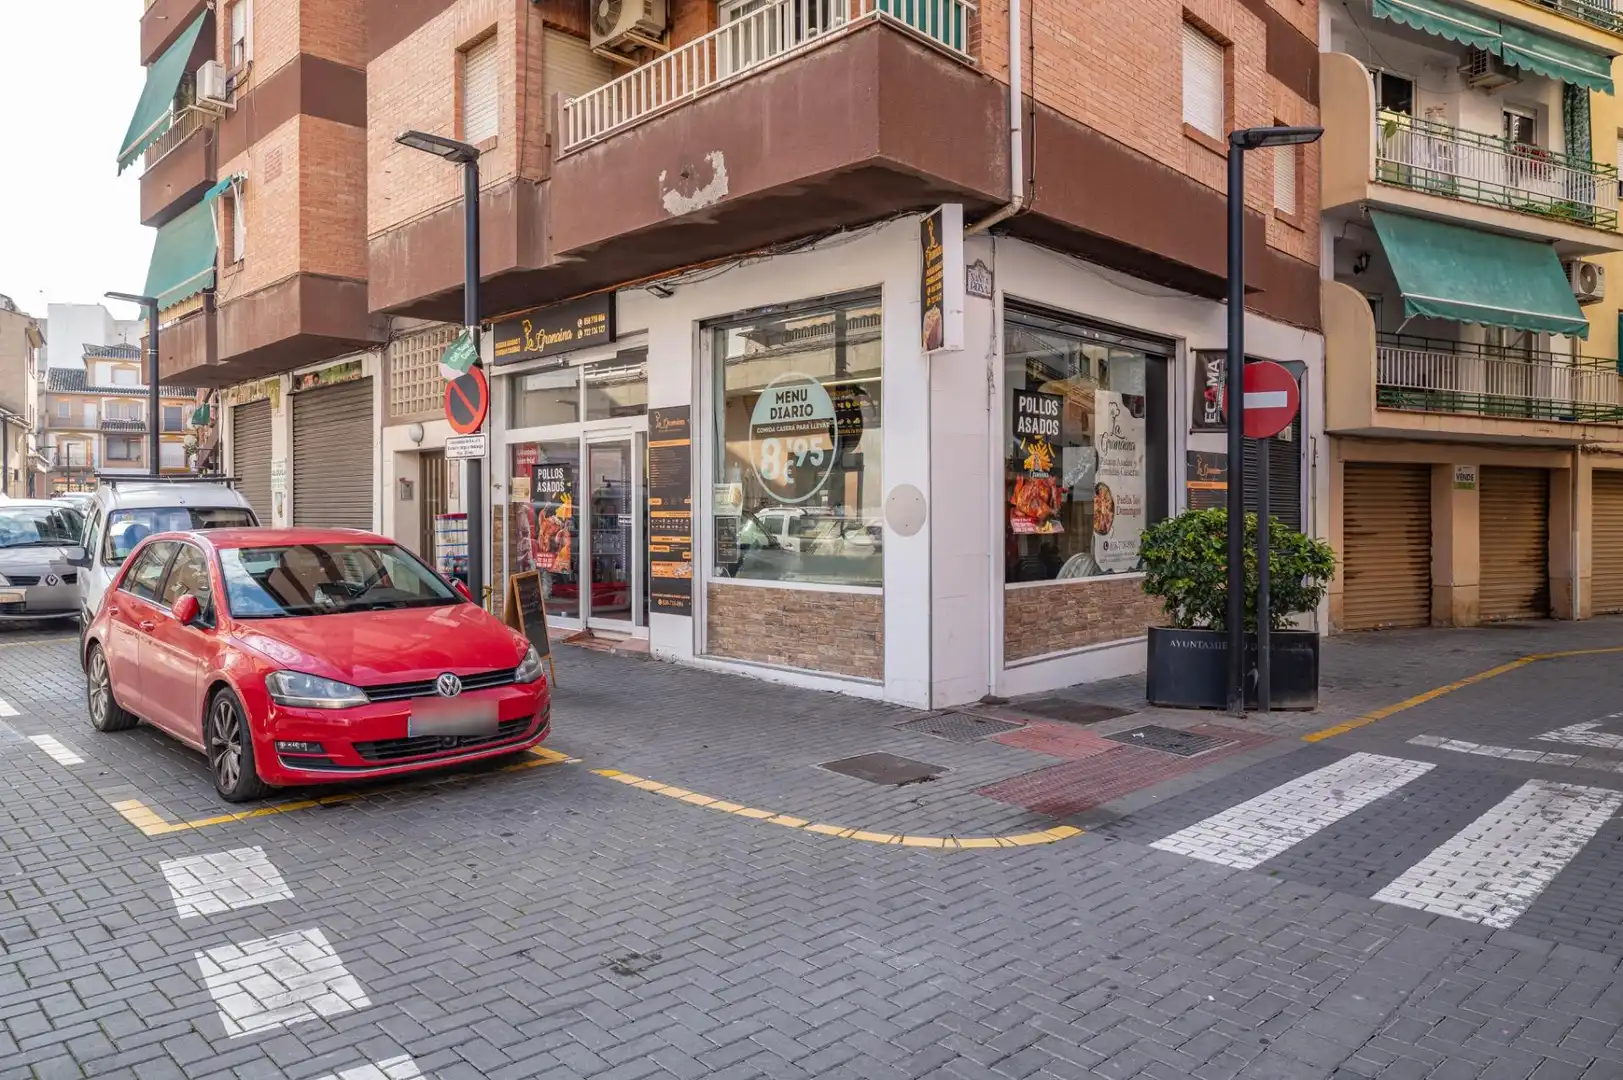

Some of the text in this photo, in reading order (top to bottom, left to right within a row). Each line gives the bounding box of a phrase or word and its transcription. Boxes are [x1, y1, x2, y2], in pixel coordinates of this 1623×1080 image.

[775, 388, 808, 404] MENU
[1204, 359, 1220, 423] ECAMA
[770, 404, 814, 420] DIARIO
[1019, 395, 1058, 415] POLLOS
[1017, 416, 1059, 436] ASADOS
[537, 467, 564, 480] POLLOS
[1455, 472, 1474, 481] VENDE
[536, 480, 565, 493] ASADOS
